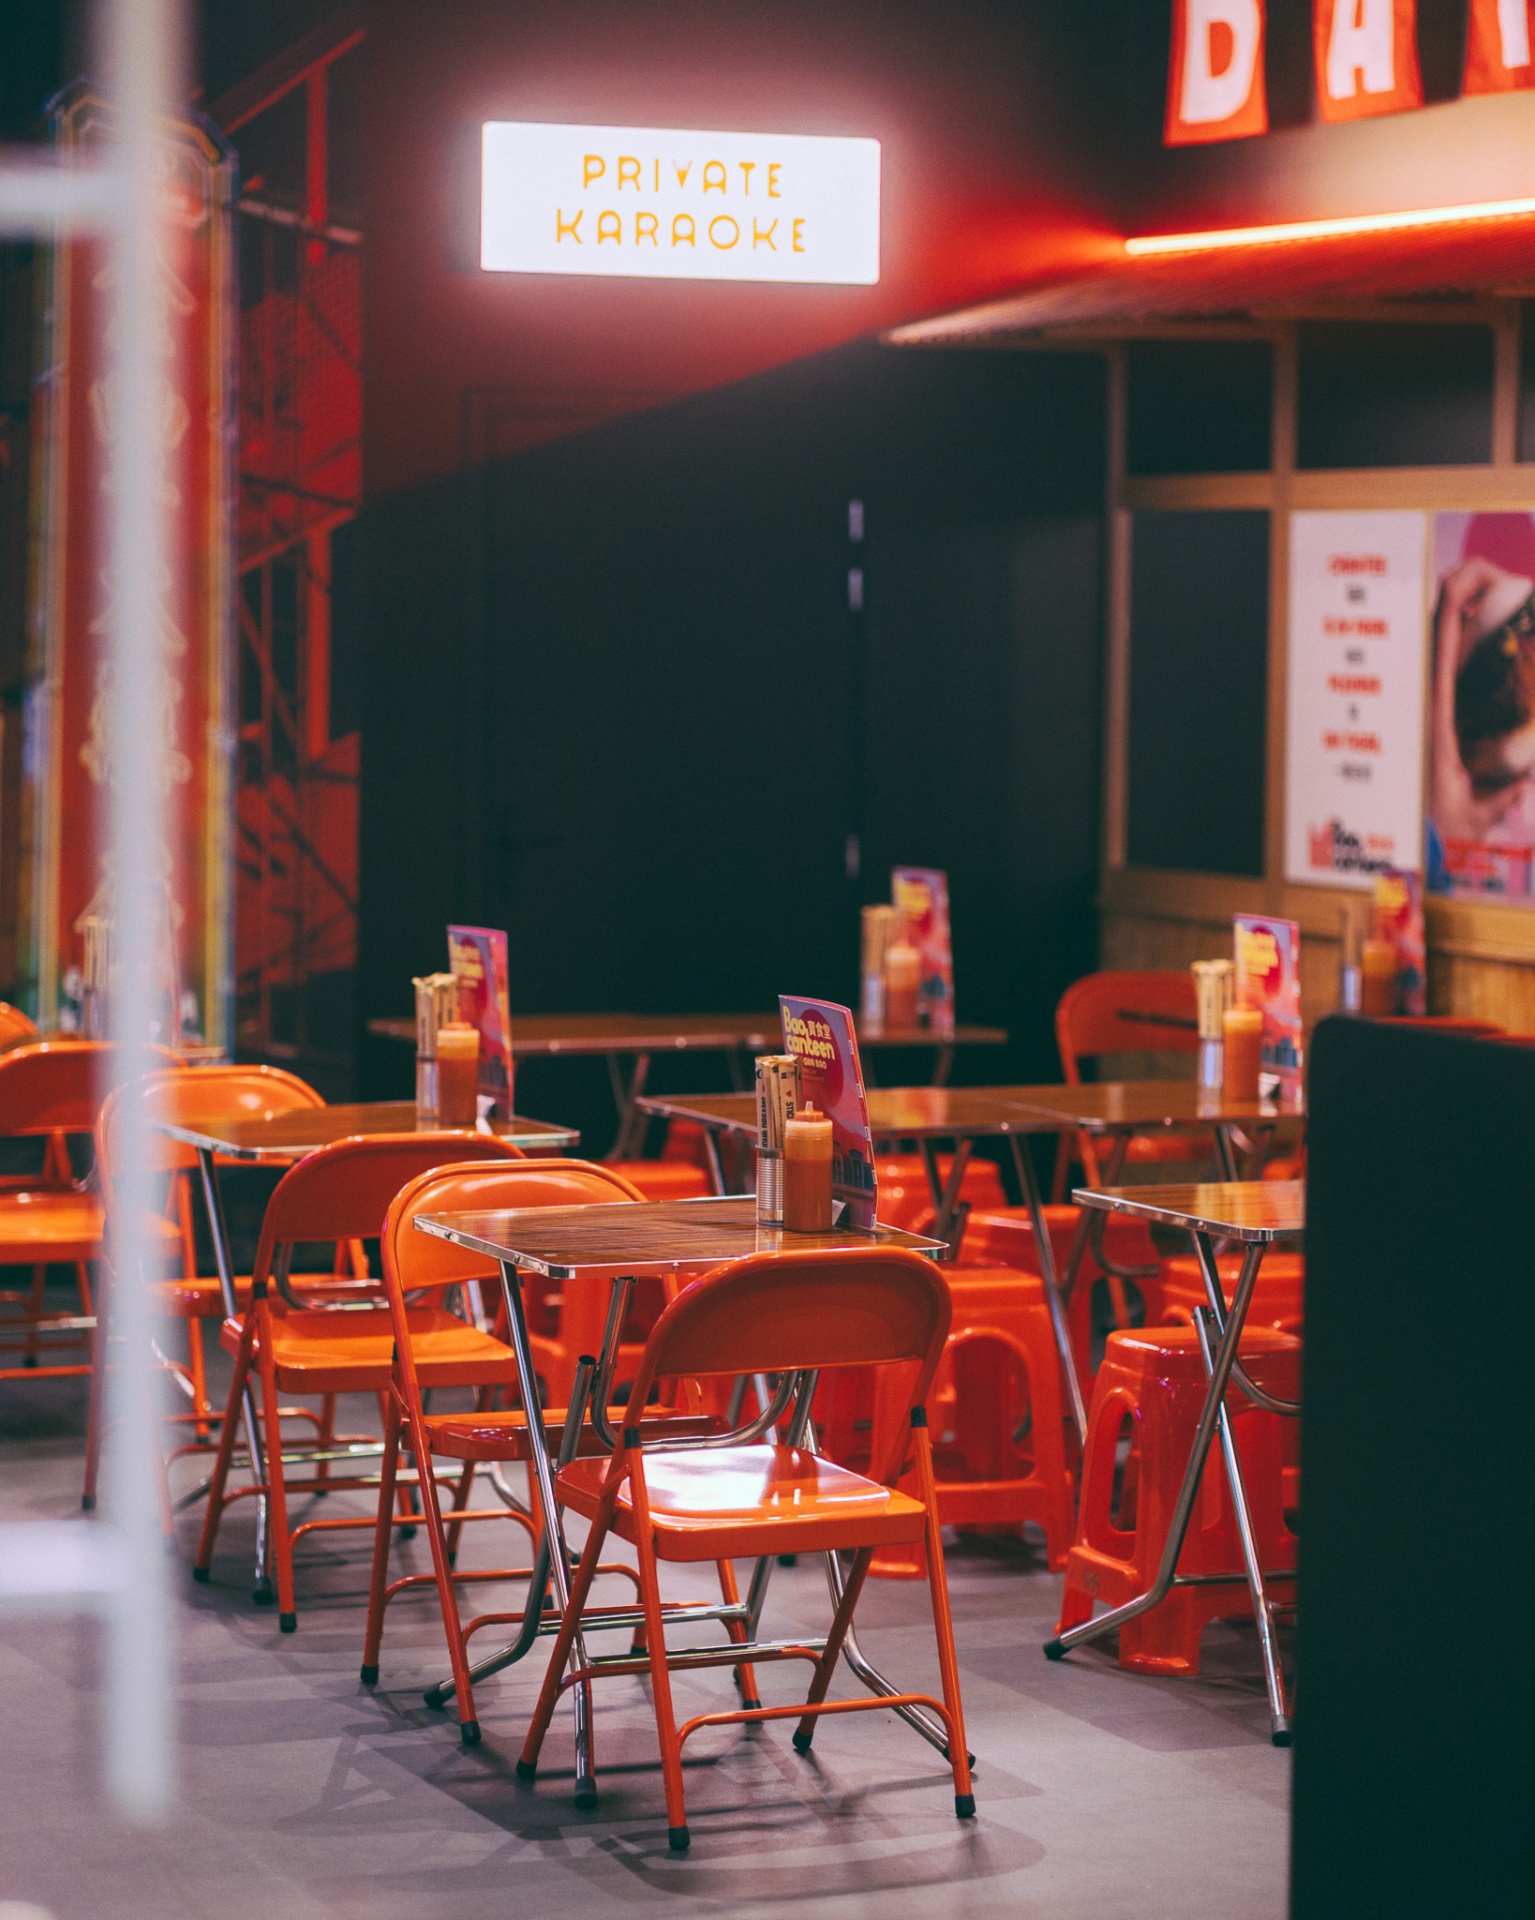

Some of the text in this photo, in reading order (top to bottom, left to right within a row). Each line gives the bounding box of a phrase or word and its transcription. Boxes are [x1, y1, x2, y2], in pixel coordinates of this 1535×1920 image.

[583, 153, 782, 198] PRIVATE
[555, 208, 806, 253] KARAOKE
[782, 1005, 807, 1036] Bao
[786, 1029, 836, 1061] canteen
